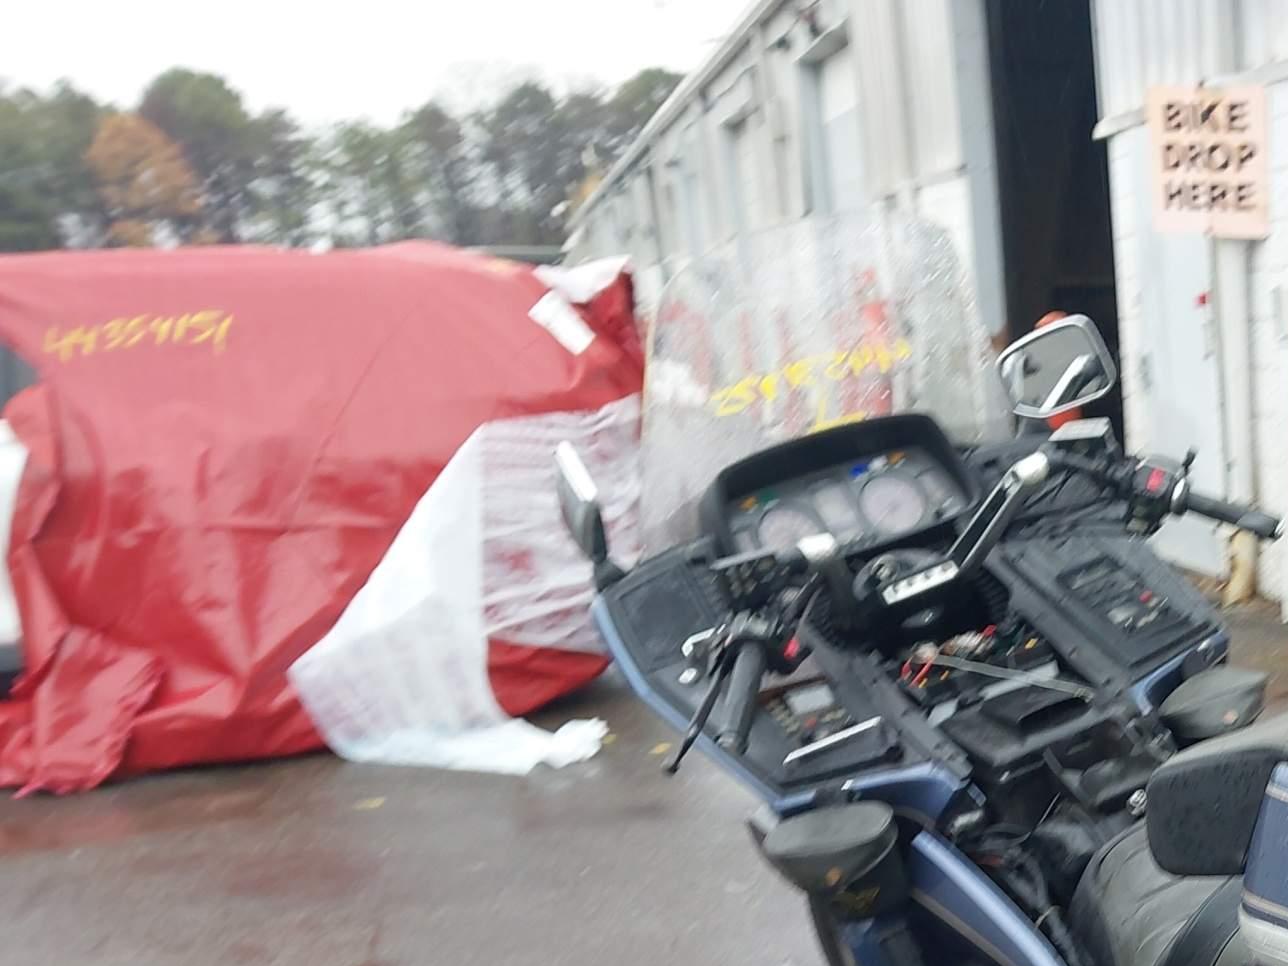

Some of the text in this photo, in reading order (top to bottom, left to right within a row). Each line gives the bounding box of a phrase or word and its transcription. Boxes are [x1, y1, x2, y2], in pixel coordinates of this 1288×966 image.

[1163, 99, 1250, 132] BIKE
[1162, 143, 1257, 172] DROP
[1163, 180, 1256, 212] HERE
